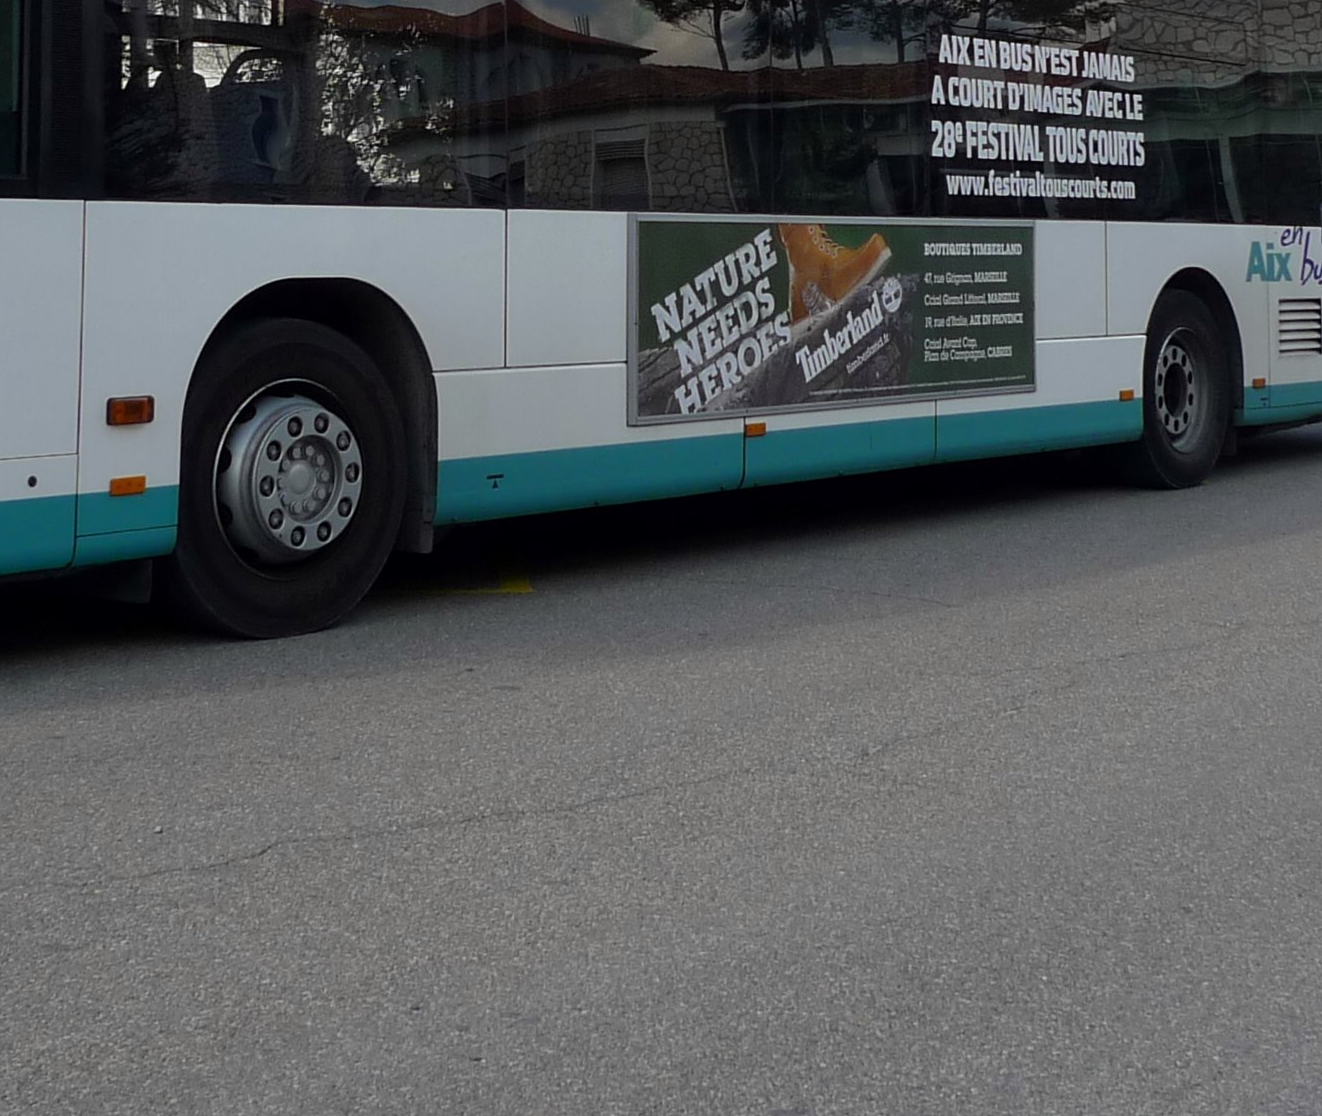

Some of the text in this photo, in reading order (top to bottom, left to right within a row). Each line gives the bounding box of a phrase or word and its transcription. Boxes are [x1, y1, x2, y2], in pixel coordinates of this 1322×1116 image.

[938, 34, 1135, 82] AIX EN BUS N'EST JAMAIS
[931, 75, 1144, 120] A COURT D'IMAGES AVEC LE
[966, 121, 1044, 162] FESTIVAL
[1046, 126, 1086, 164] TOUS
[1089, 129, 1145, 167] COURTS
[946, 170, 1136, 199] www.festivaltouscourts.com
[924, 243, 1023, 256] BOUTIQUES TIMBERLAND
[1245, 241, 1293, 282] Aix
[1280, 226, 1303, 246] en
[650, 228, 778, 343] NATURE
[674, 276, 775, 378] NEEDS
[795, 290, 884, 383] Timberland
[674, 310, 791, 415] HEROES
